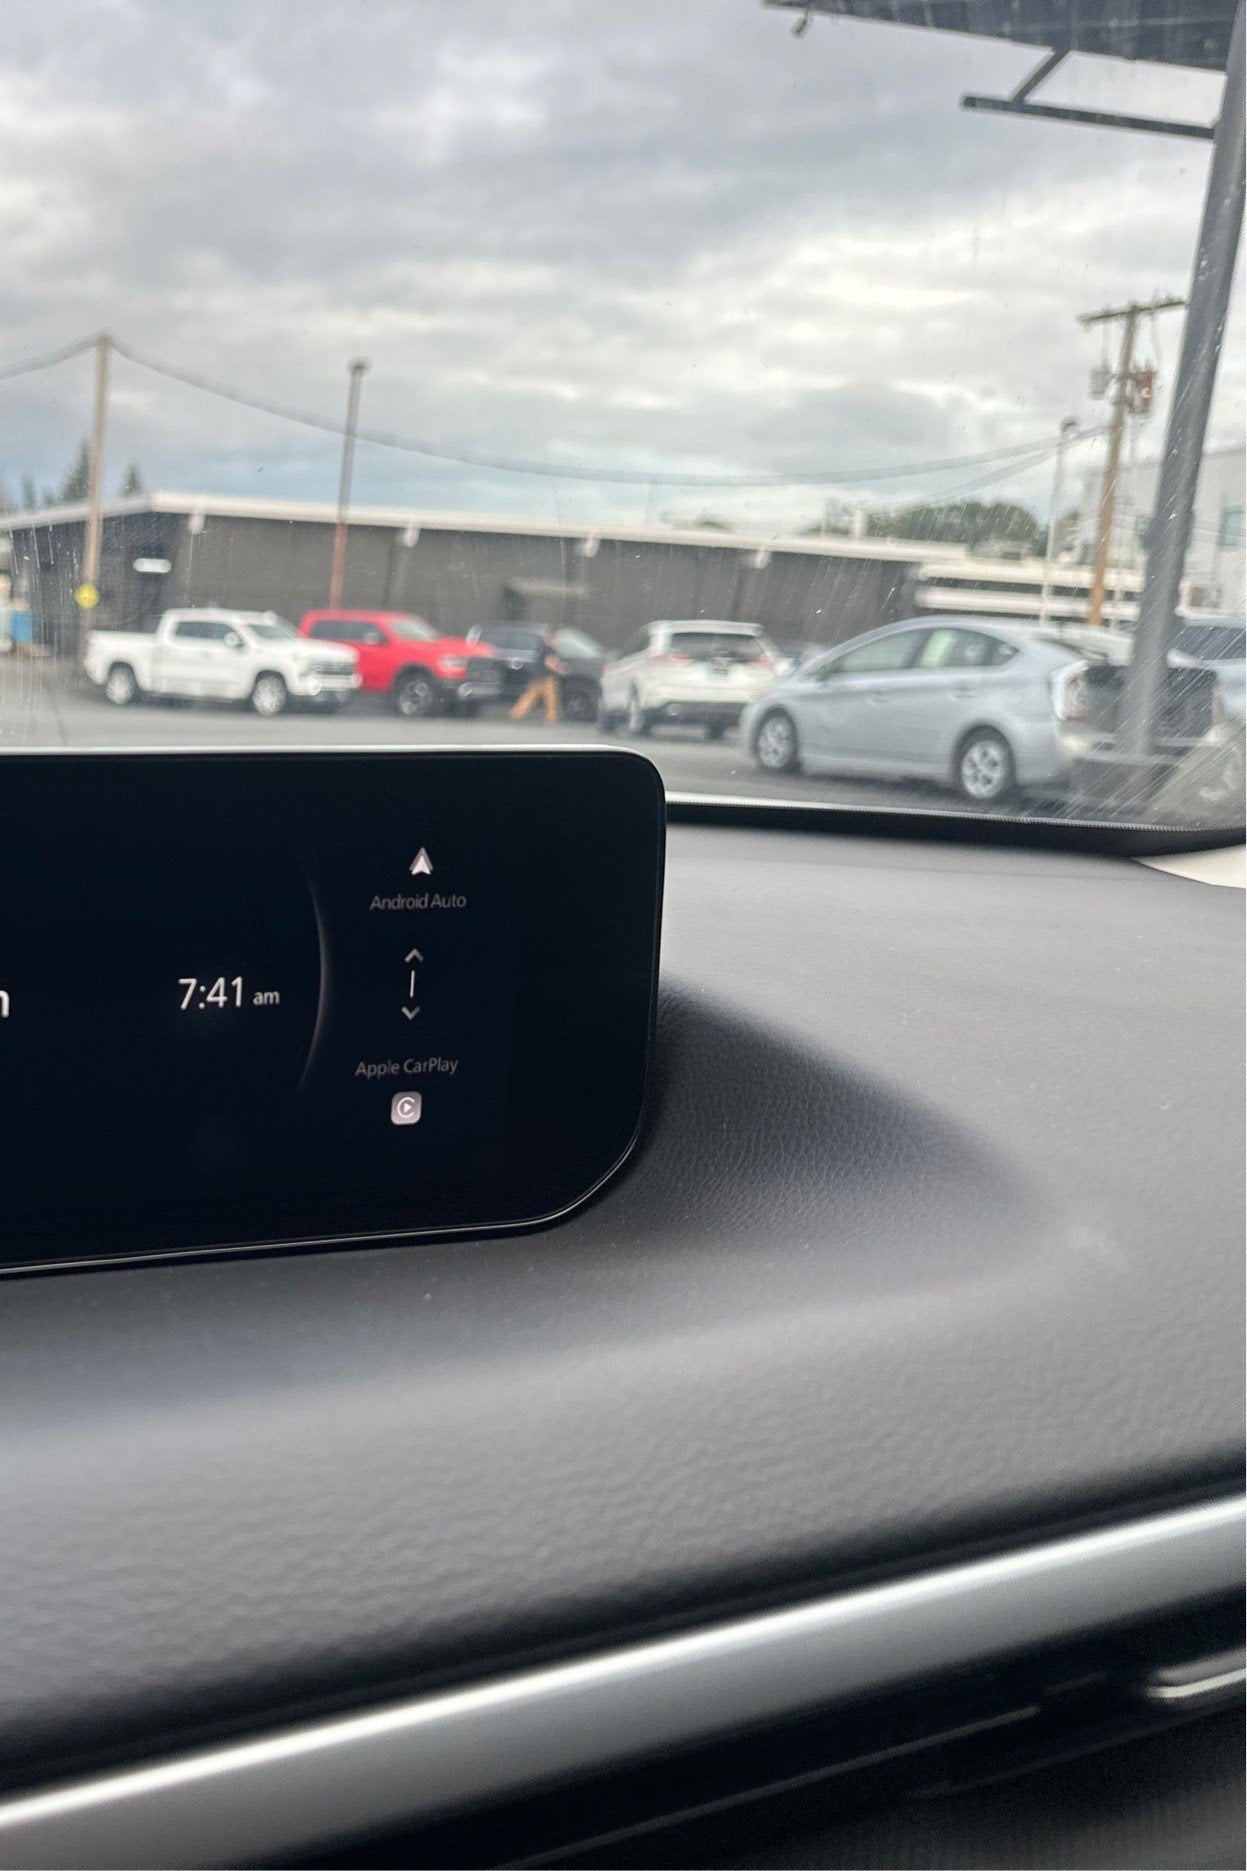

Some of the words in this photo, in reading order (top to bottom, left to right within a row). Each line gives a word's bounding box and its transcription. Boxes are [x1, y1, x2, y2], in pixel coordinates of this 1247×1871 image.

[369, 892, 430, 911] Android
[431, 893, 468, 909] Auto
[178, 976, 244, 1011] 7:41
[252, 990, 281, 1007] am
[354, 1059, 401, 1079] Apple
[403, 1056, 460, 1076] CarPlay
